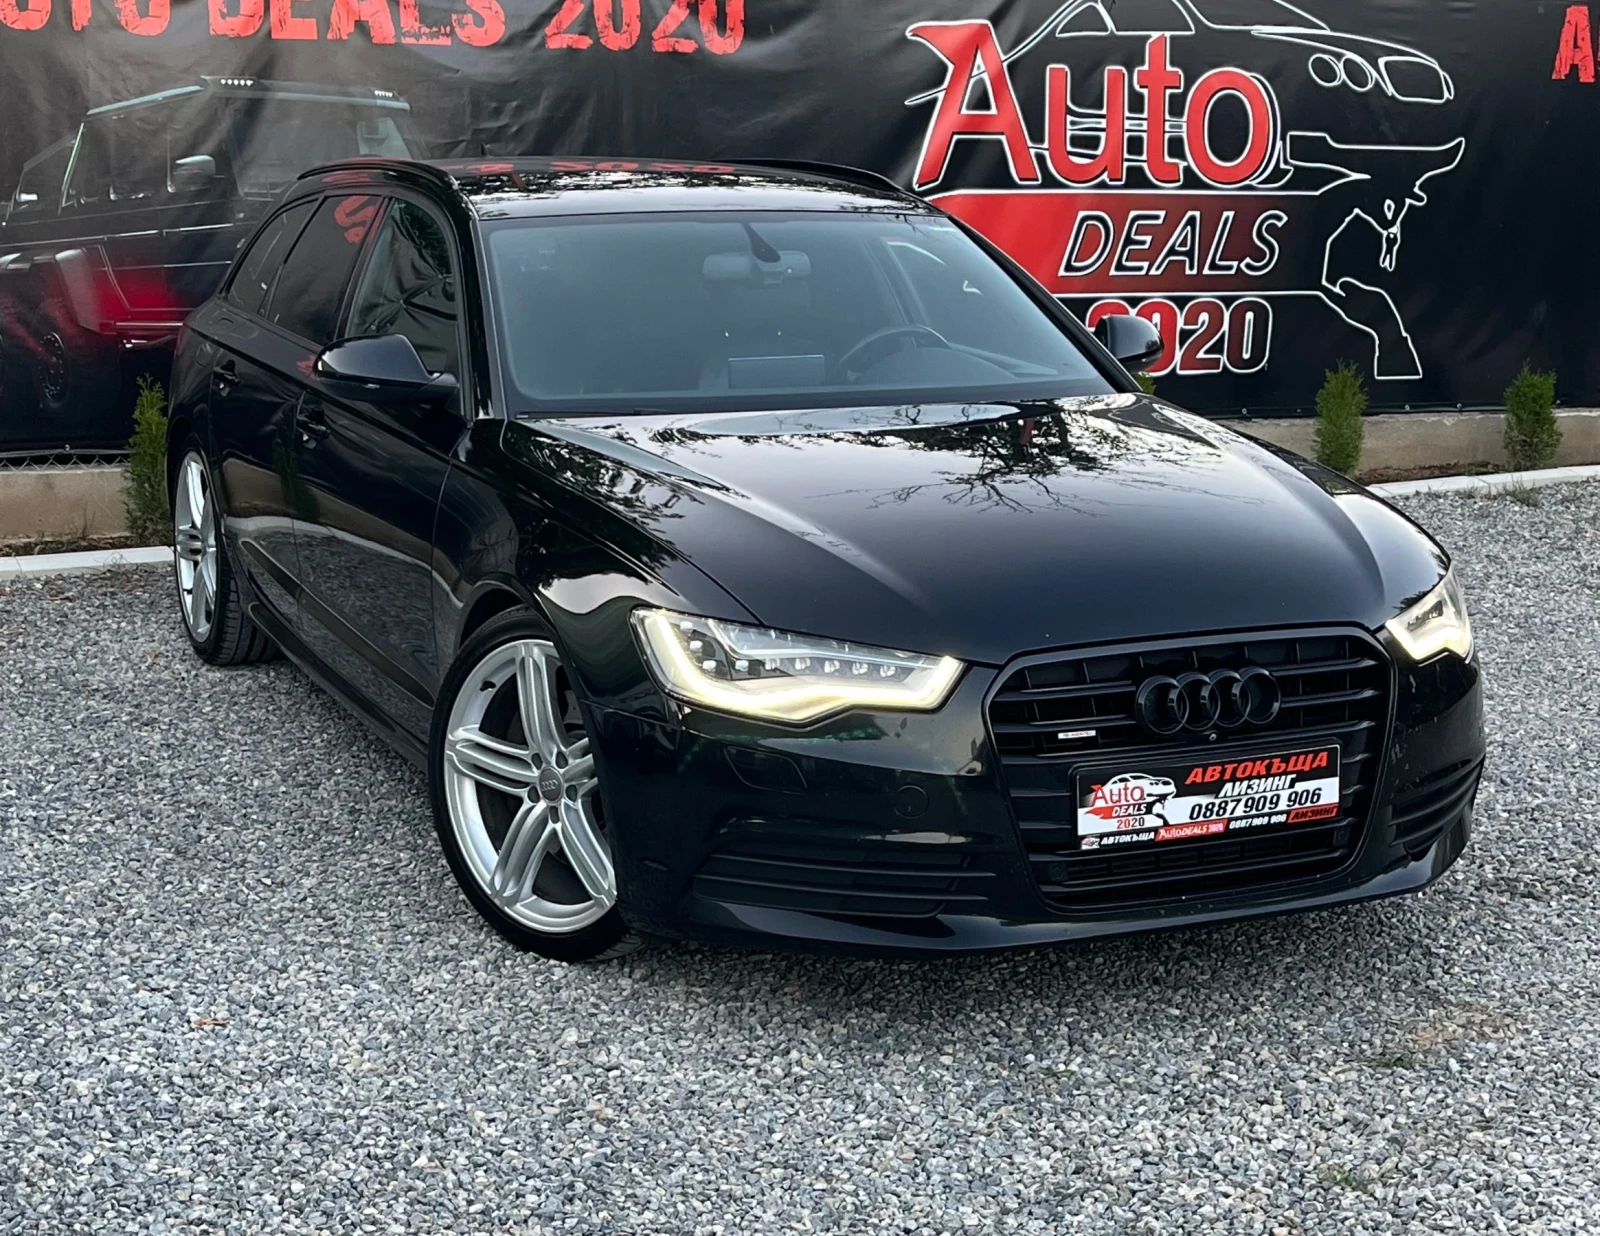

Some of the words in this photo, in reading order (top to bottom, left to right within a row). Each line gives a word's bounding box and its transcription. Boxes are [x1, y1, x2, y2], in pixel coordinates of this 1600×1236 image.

[1551, 4, 1600, 83] A
[906, 20, 1272, 190] Auto
[1058, 210, 1288, 277] DEALS
[1184, 751, 1328, 785] АВТОКЪЩА
[1090, 782, 1146, 807] Auto
[1217, 774, 1297, 798] ЛИЗИНГ
[1111, 804, 1147, 818] DEALS
[1188, 799, 1242, 821] 0887
[1242, 793, 1281, 814] 909
[1286, 787, 1323, 808] 906
[1116, 817, 1145, 829] 2020
[1100, 831, 1155, 845] АВТОКЪЩА
